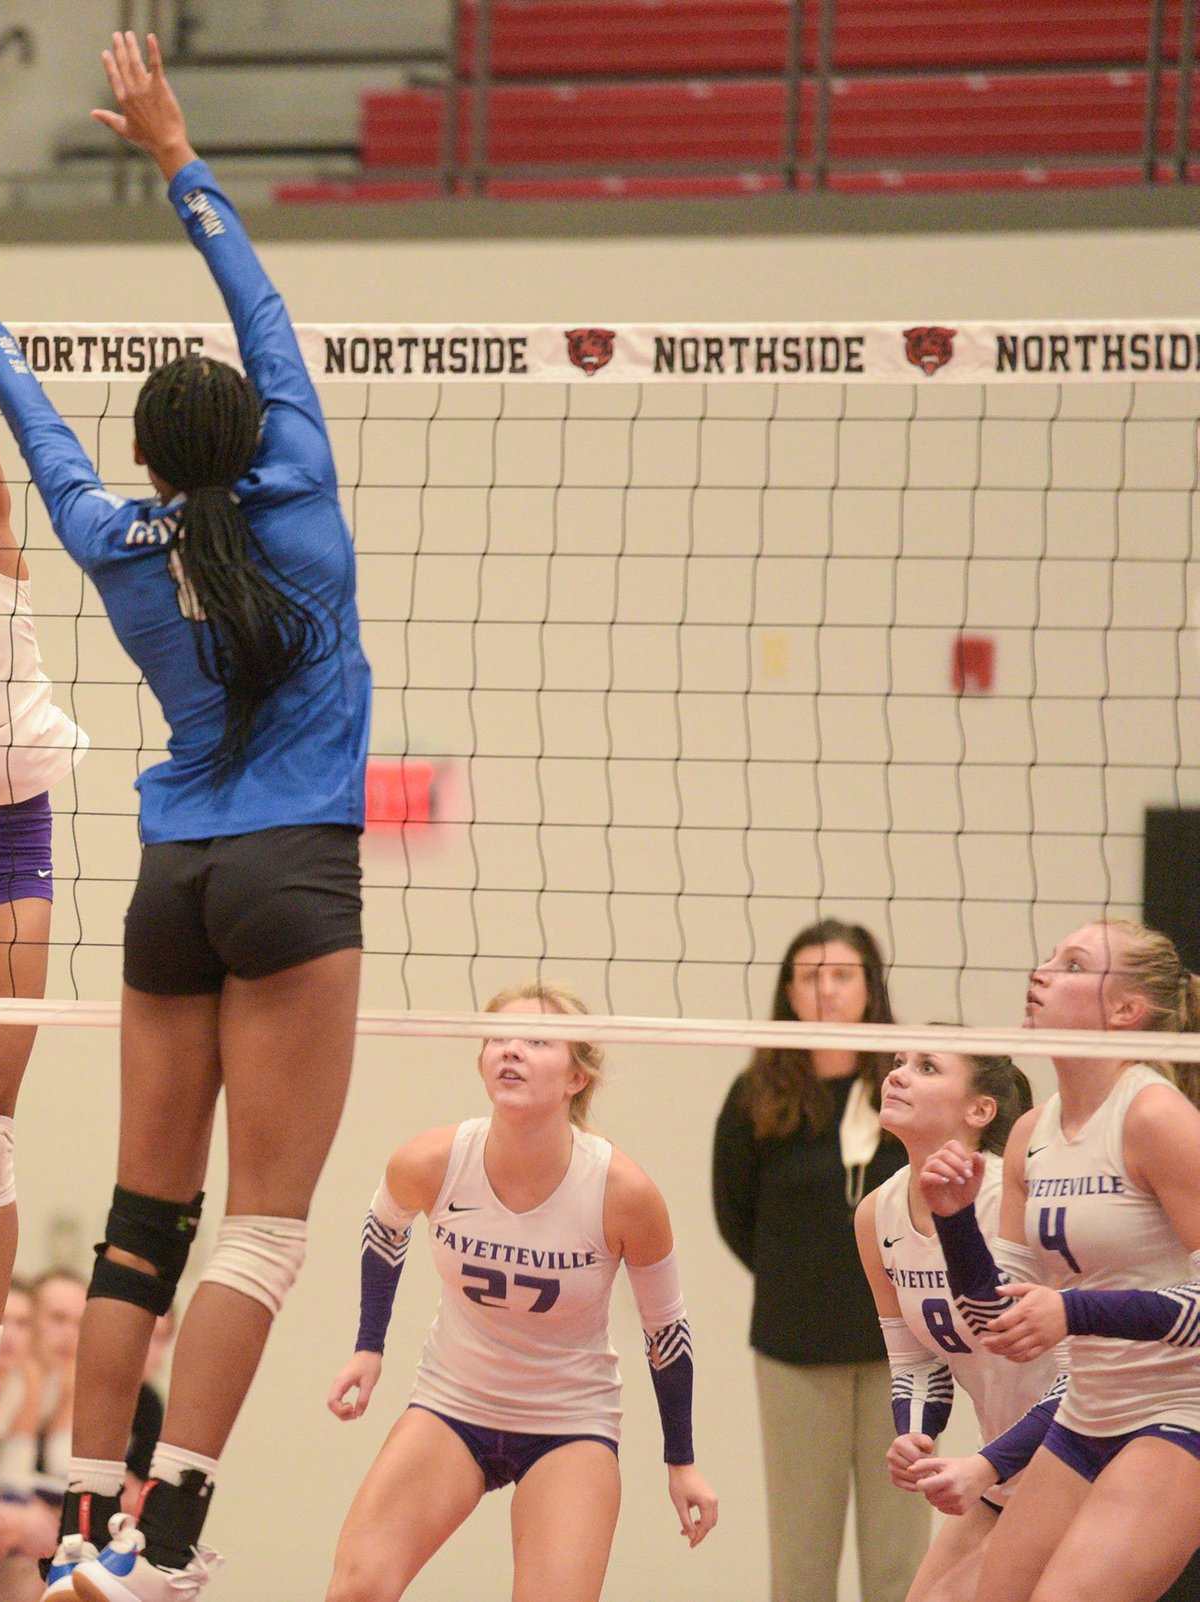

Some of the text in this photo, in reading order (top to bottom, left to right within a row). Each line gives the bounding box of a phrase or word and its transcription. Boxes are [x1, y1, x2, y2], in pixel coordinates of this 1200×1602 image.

[324, 337, 528, 374] NORTHSIDE
[654, 336, 865, 373] NORTHSIDE
[996, 334, 1200, 372] NORTHSID
[435, 1224, 597, 1270] FAYETTEVILLE
[1039, 1207, 1082, 1274] 4
[461, 1263, 560, 1313] 27
[885, 1268, 948, 1289] FAYETTE
[922, 1298, 972, 1353] 8
